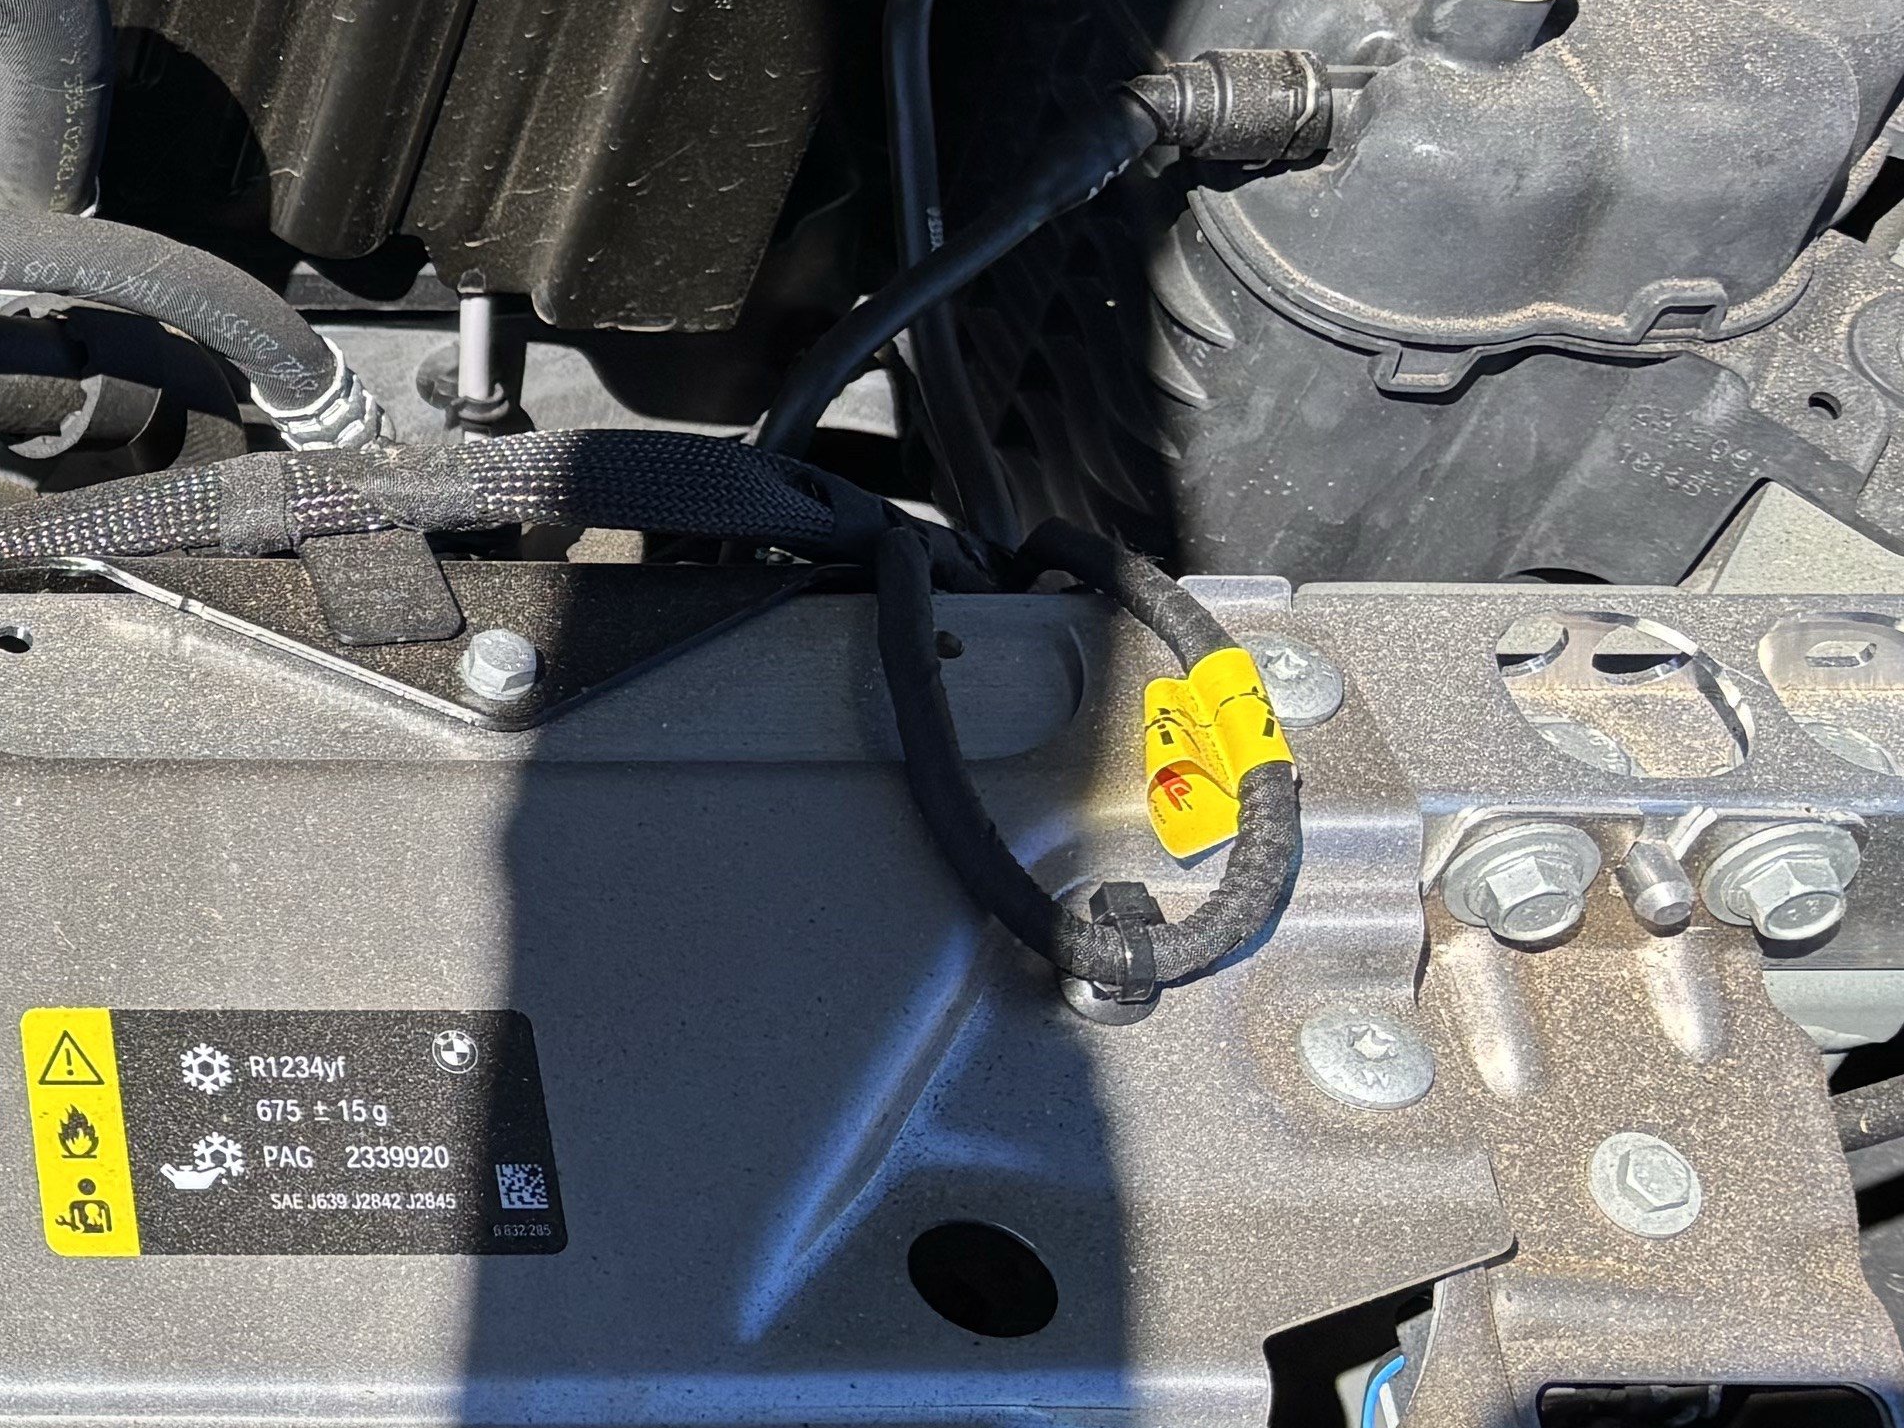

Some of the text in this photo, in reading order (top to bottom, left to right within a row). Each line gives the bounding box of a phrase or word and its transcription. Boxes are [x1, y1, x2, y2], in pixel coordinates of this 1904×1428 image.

[249, 1055, 346, 1080] R1234yf
[255, 1100, 301, 1122] 675
[337, 1100, 367, 1121] 15
[375, 1103, 389, 1126] g
[263, 1145, 450, 1169] PAG 2339920
[270, 1192, 457, 1210] SAE J639 J2842 J2845
